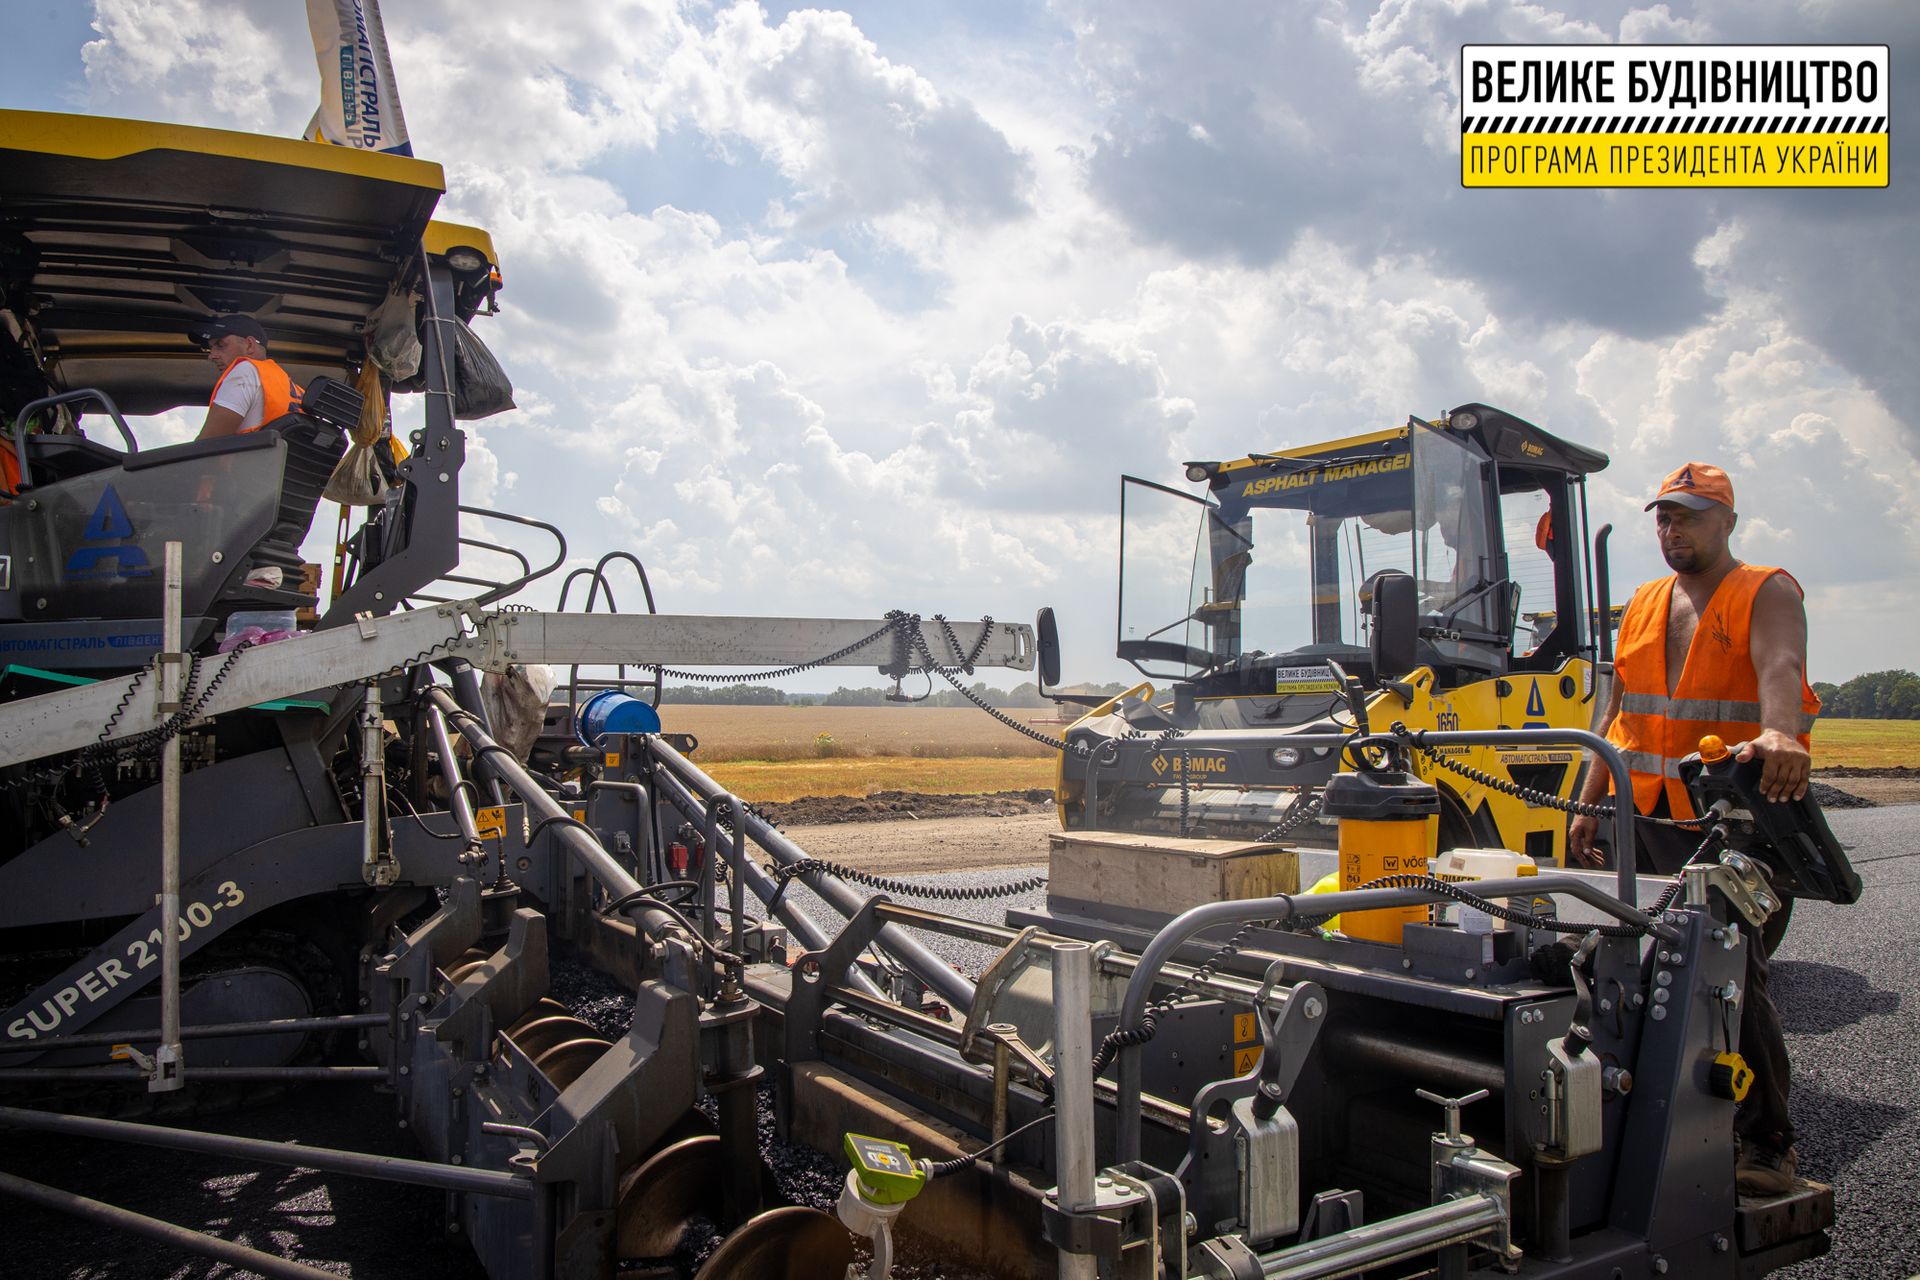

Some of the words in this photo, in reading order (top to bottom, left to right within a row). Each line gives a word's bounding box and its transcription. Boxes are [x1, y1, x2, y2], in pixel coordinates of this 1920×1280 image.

[1242, 469, 1319, 497] ASPHALT
[0, 636, 105, 652] ВТОМАГІСТРАЛЬ
[115, 633, 161, 646] ПІВДЕН
[1301, 668, 1331, 678] БУДІВНИЦ
[1436, 712, 1459, 731] 1650
[1173, 757, 1226, 773] BMAG
[1501, 753, 1548, 764] АВТОМАГІСТРАЛЬ
[7, 958, 132, 1039] SUPER
